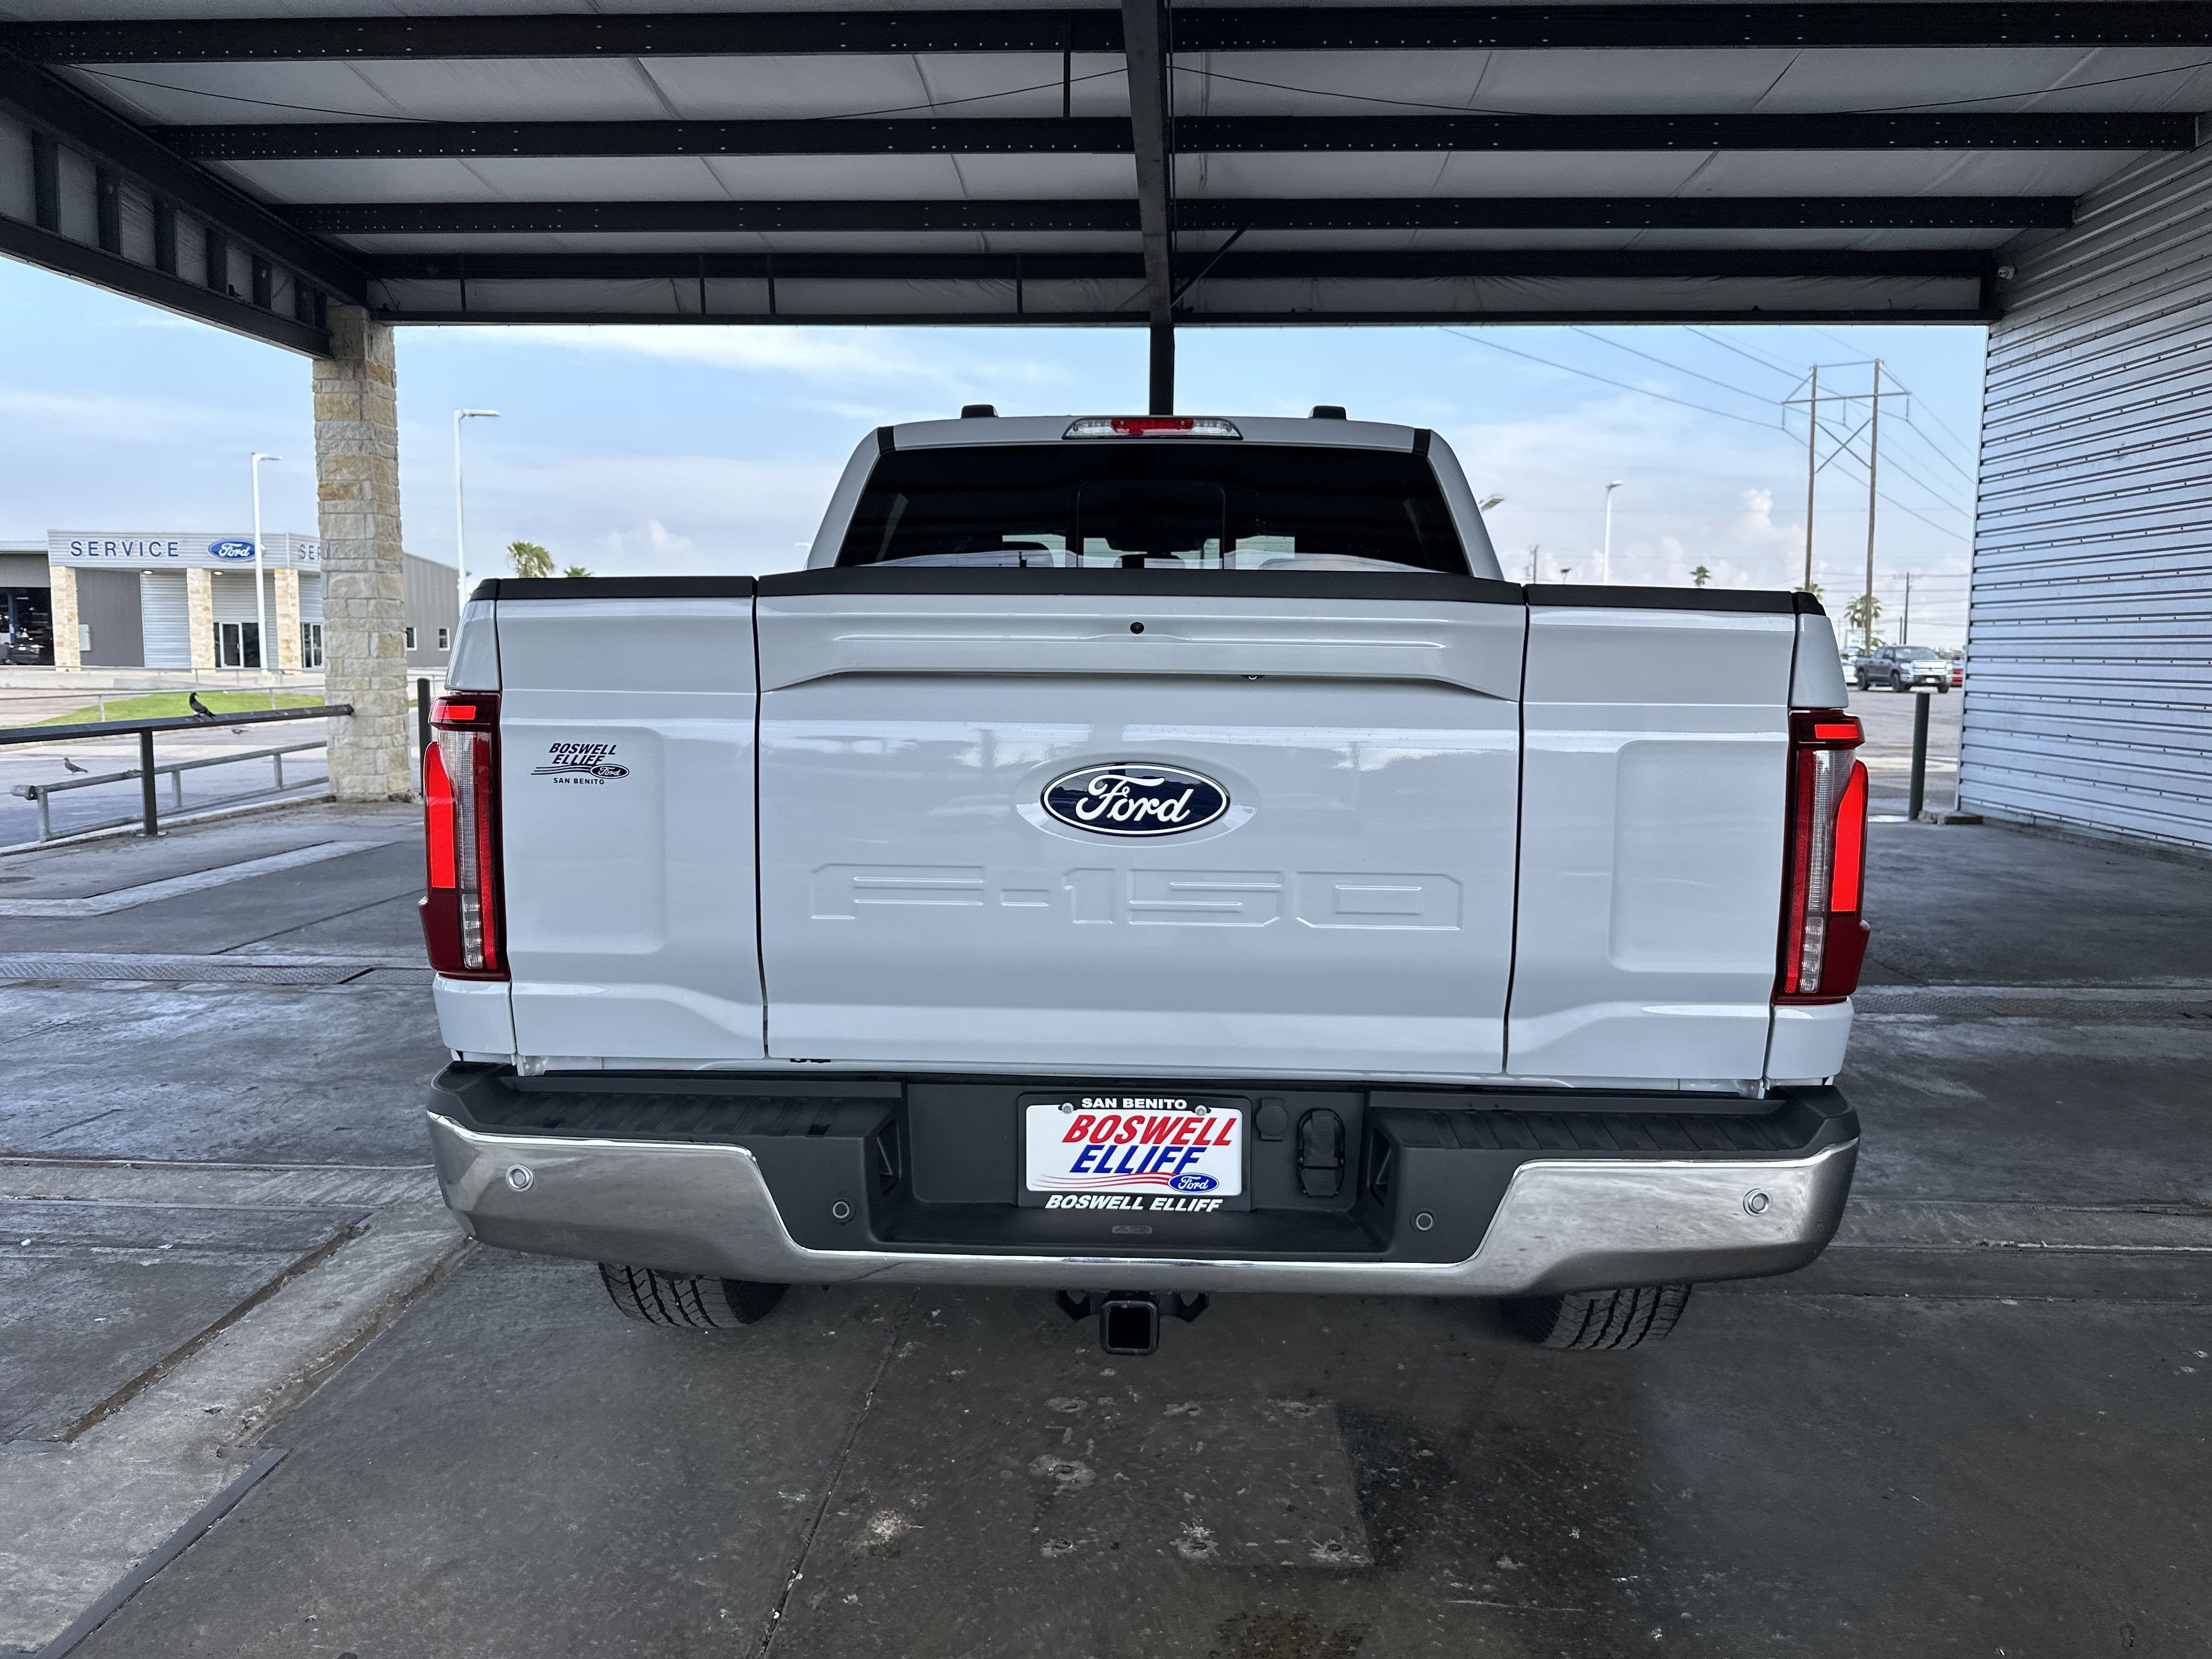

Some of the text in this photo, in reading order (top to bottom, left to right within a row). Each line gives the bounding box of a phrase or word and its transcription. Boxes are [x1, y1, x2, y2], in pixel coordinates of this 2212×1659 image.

[70, 540, 179, 557] SERVICE
[218, 543, 251, 557] Ford
[298, 544, 320, 560] SE
[549, 743, 617, 755] BOSWELL
[552, 754, 605, 765] ELLIFF
[597, 766, 621, 776] Ford
[1075, 774, 1194, 822] Ford
[810, 864, 1462, 931] F-150
[1081, 1098, 1187, 1110] SAN BENITO
[1062, 1114, 1238, 1146] BOSWELL
[1069, 1144, 1207, 1174] ELLIFF
[1177, 1176, 1209, 1191] Ford
[1045, 1194, 1223, 1212] BOSWELL ELLIFF
